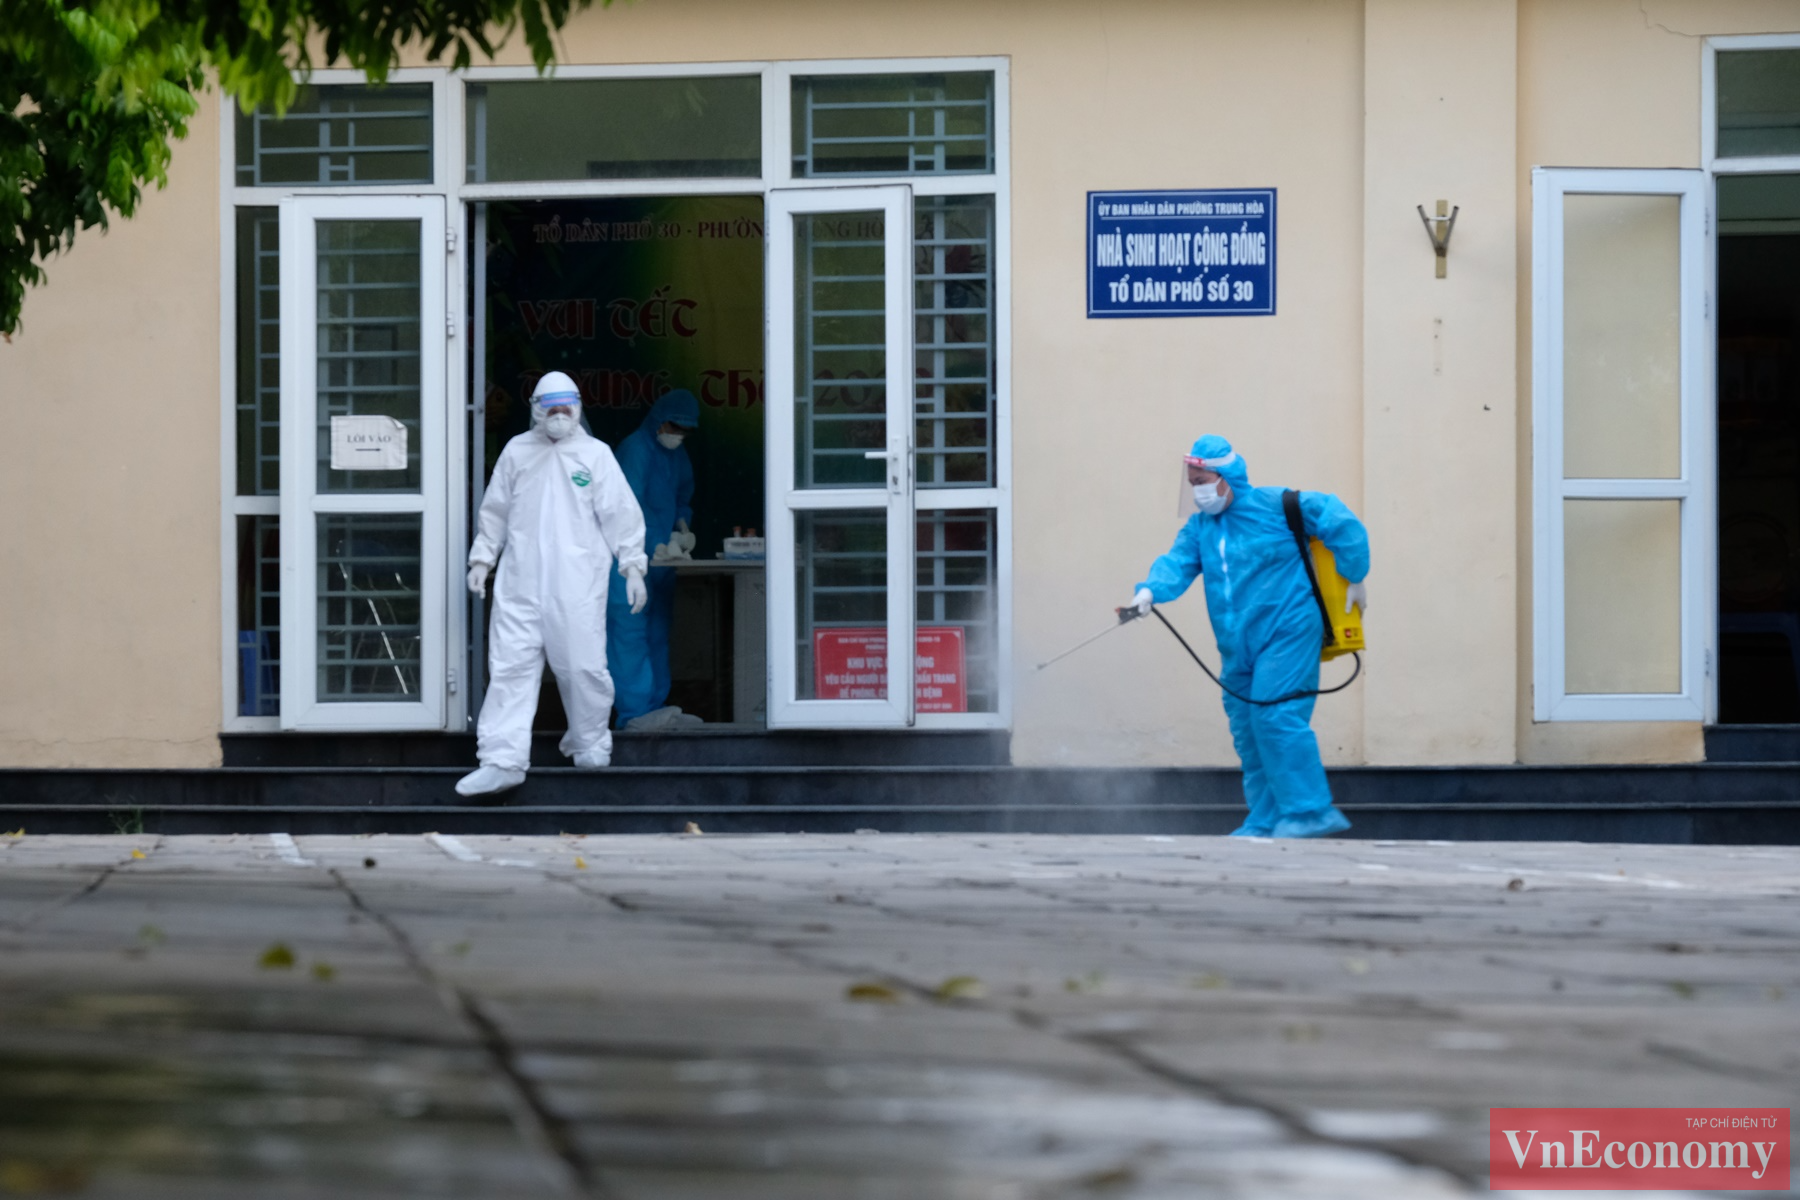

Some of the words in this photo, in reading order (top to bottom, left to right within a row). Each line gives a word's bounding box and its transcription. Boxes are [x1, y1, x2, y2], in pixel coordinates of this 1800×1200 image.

[1112, 204, 1130, 216] BAN
[1132, 201, 1155, 216] NHÂN
[1157, 201, 1175, 215] DÂN
[1177, 201, 1213, 215] PHƯỜNG
[1215, 203, 1244, 214] TRUNG
[1246, 200, 1264, 214] HÒA
[565, 217, 610, 243] DÂN
[658, 221, 681, 239] 30
[698, 215, 763, 238] PHƯỜN
[1097, 227, 1123, 267] NHÀ
[1126, 233, 1156, 267] SINH
[1159, 233, 1191, 273] HOẠT
[1194, 226, 1228, 273] CỘNG
[1109, 273, 1130, 302] TỔ
[1133, 277, 1166, 302] DÂN
[1171, 273, 1203, 302] PHỐ
[1207, 273, 1230, 302] SỐ
[1233, 280, 1254, 302] 30
[517, 298, 597, 341] VUI
[848, 657, 864, 668] KHU
